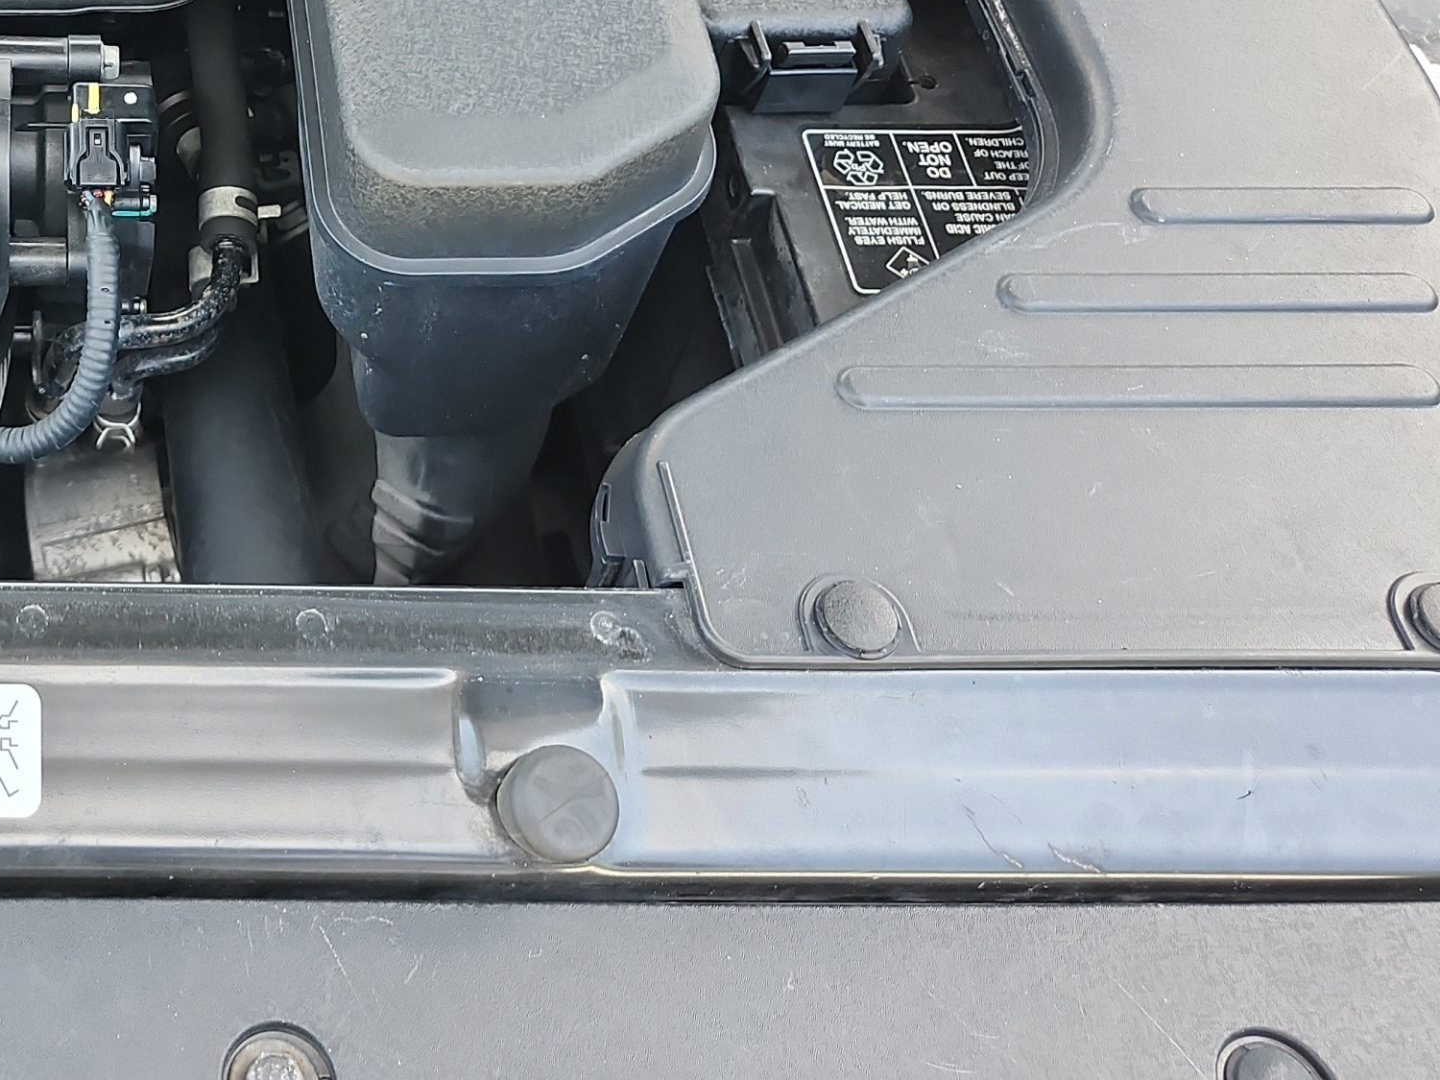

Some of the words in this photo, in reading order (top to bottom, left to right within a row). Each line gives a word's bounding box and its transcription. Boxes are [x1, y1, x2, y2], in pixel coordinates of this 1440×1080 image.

[965, 137, 1025, 146] CHILDREN.
[902, 141, 952, 153] OPEN.
[973, 149, 989, 157] OF
[990, 149, 1029, 158] REACH
[918, 154, 952, 166] NOT
[851, 163, 867, 172] Pb
[994, 161, 1017, 169] THE
[926, 167, 952, 178] DO
[984, 171, 1007, 180] OUT
[1009, 172, 1030, 181] EEP
[844, 191, 876, 200] FAST.
[878, 191, 908, 200] HELP
[921, 191, 965, 200] BURNS.
[965, 191, 1011, 200] SEVERE
[835, 201, 886, 210] MEDICAL
[888, 201, 912, 210] GET
[931, 202, 950, 211] OR
[951, 202, 1016, 211] BLINDNESS
[844, 217, 888, 226] WATER.
[888, 217, 919, 226] WITH
[954, 213, 993, 222] CAUSE
[848, 226, 922, 236] IMMEDIATELY
[945, 223, 971, 235] ACID
[854, 236, 886, 245] EYES
[886, 236, 925, 245] FLUSH
